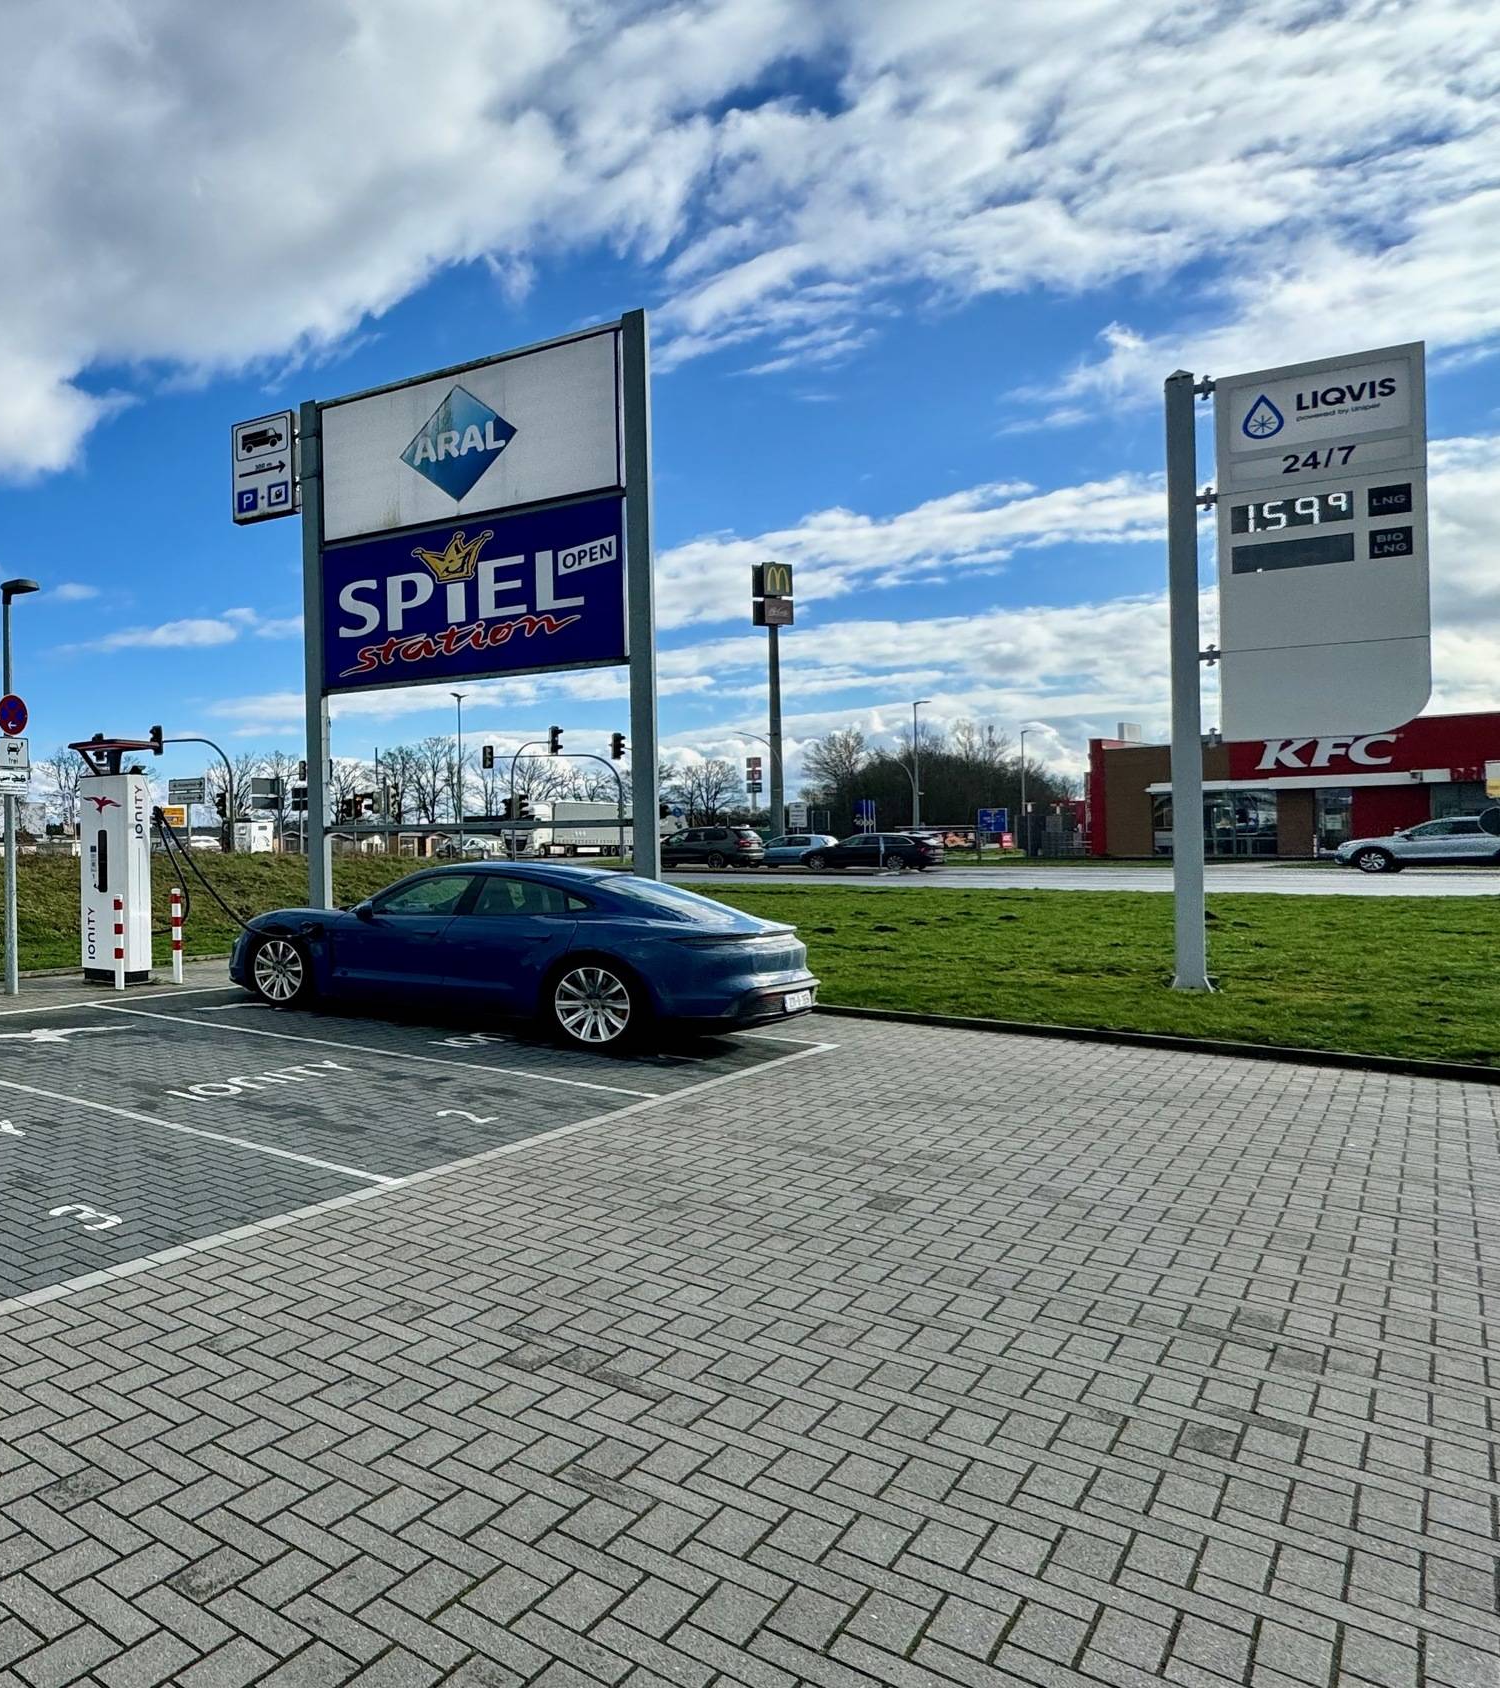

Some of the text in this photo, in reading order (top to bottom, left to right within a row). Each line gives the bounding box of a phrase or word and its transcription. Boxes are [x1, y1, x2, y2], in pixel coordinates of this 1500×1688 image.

[1296, 378, 1396, 411] LIQVIS
[413, 421, 506, 466] ARAL
[1282, 445, 1356, 474] 24/7
[243, 493, 253, 509] P
[1372, 495, 1406, 507] LNG
[1373, 542, 1407, 554] LNG
[1376, 532, 1404, 543] BIO
[562, 540, 613, 570] OPEN
[339, 550, 585, 638] SPIEL
[339, 614, 581, 677] station
[1254, 734, 1398, 770] KFC
[134, 785, 143, 839] IONITY
[87, 906, 96, 960] IONITY
[165, 1060, 354, 1102] IONITY
[436, 1110, 499, 1124] 2
[49, 1204, 123, 1231] 3
